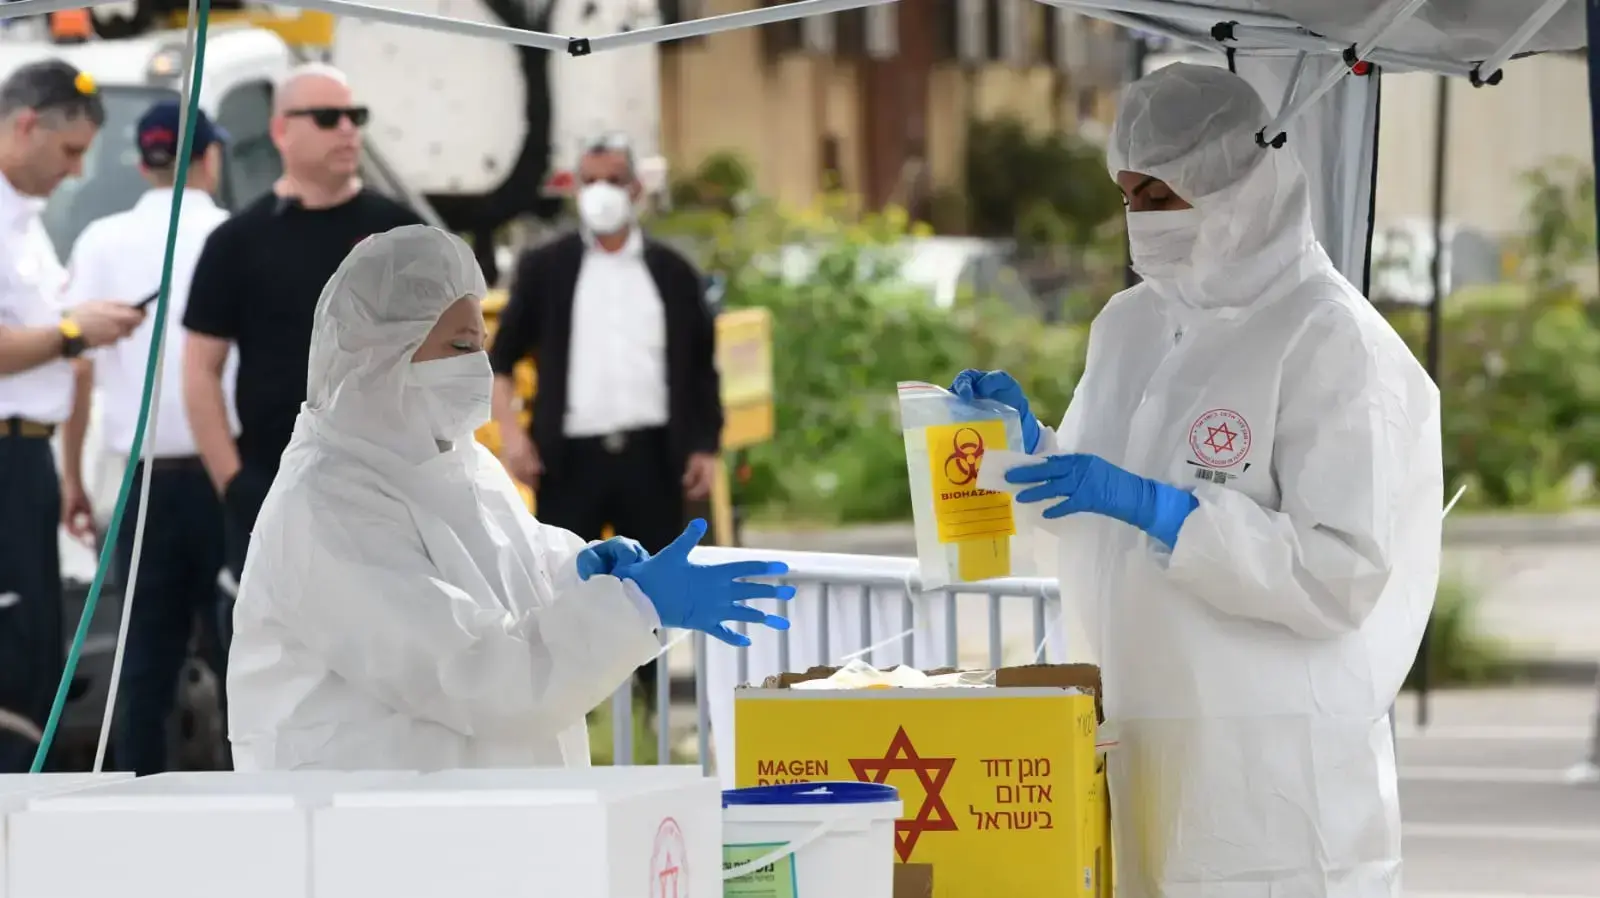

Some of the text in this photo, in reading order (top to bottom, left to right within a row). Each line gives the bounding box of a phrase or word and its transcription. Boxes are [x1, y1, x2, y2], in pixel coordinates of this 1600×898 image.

[941, 489, 1001, 500] BIOHAZA
[758, 759, 829, 776] MAGEN
[980, 757, 1052, 783] מגן דוד
[996, 783, 1053, 804] אדום
[968, 804, 1054, 830] בישראל
